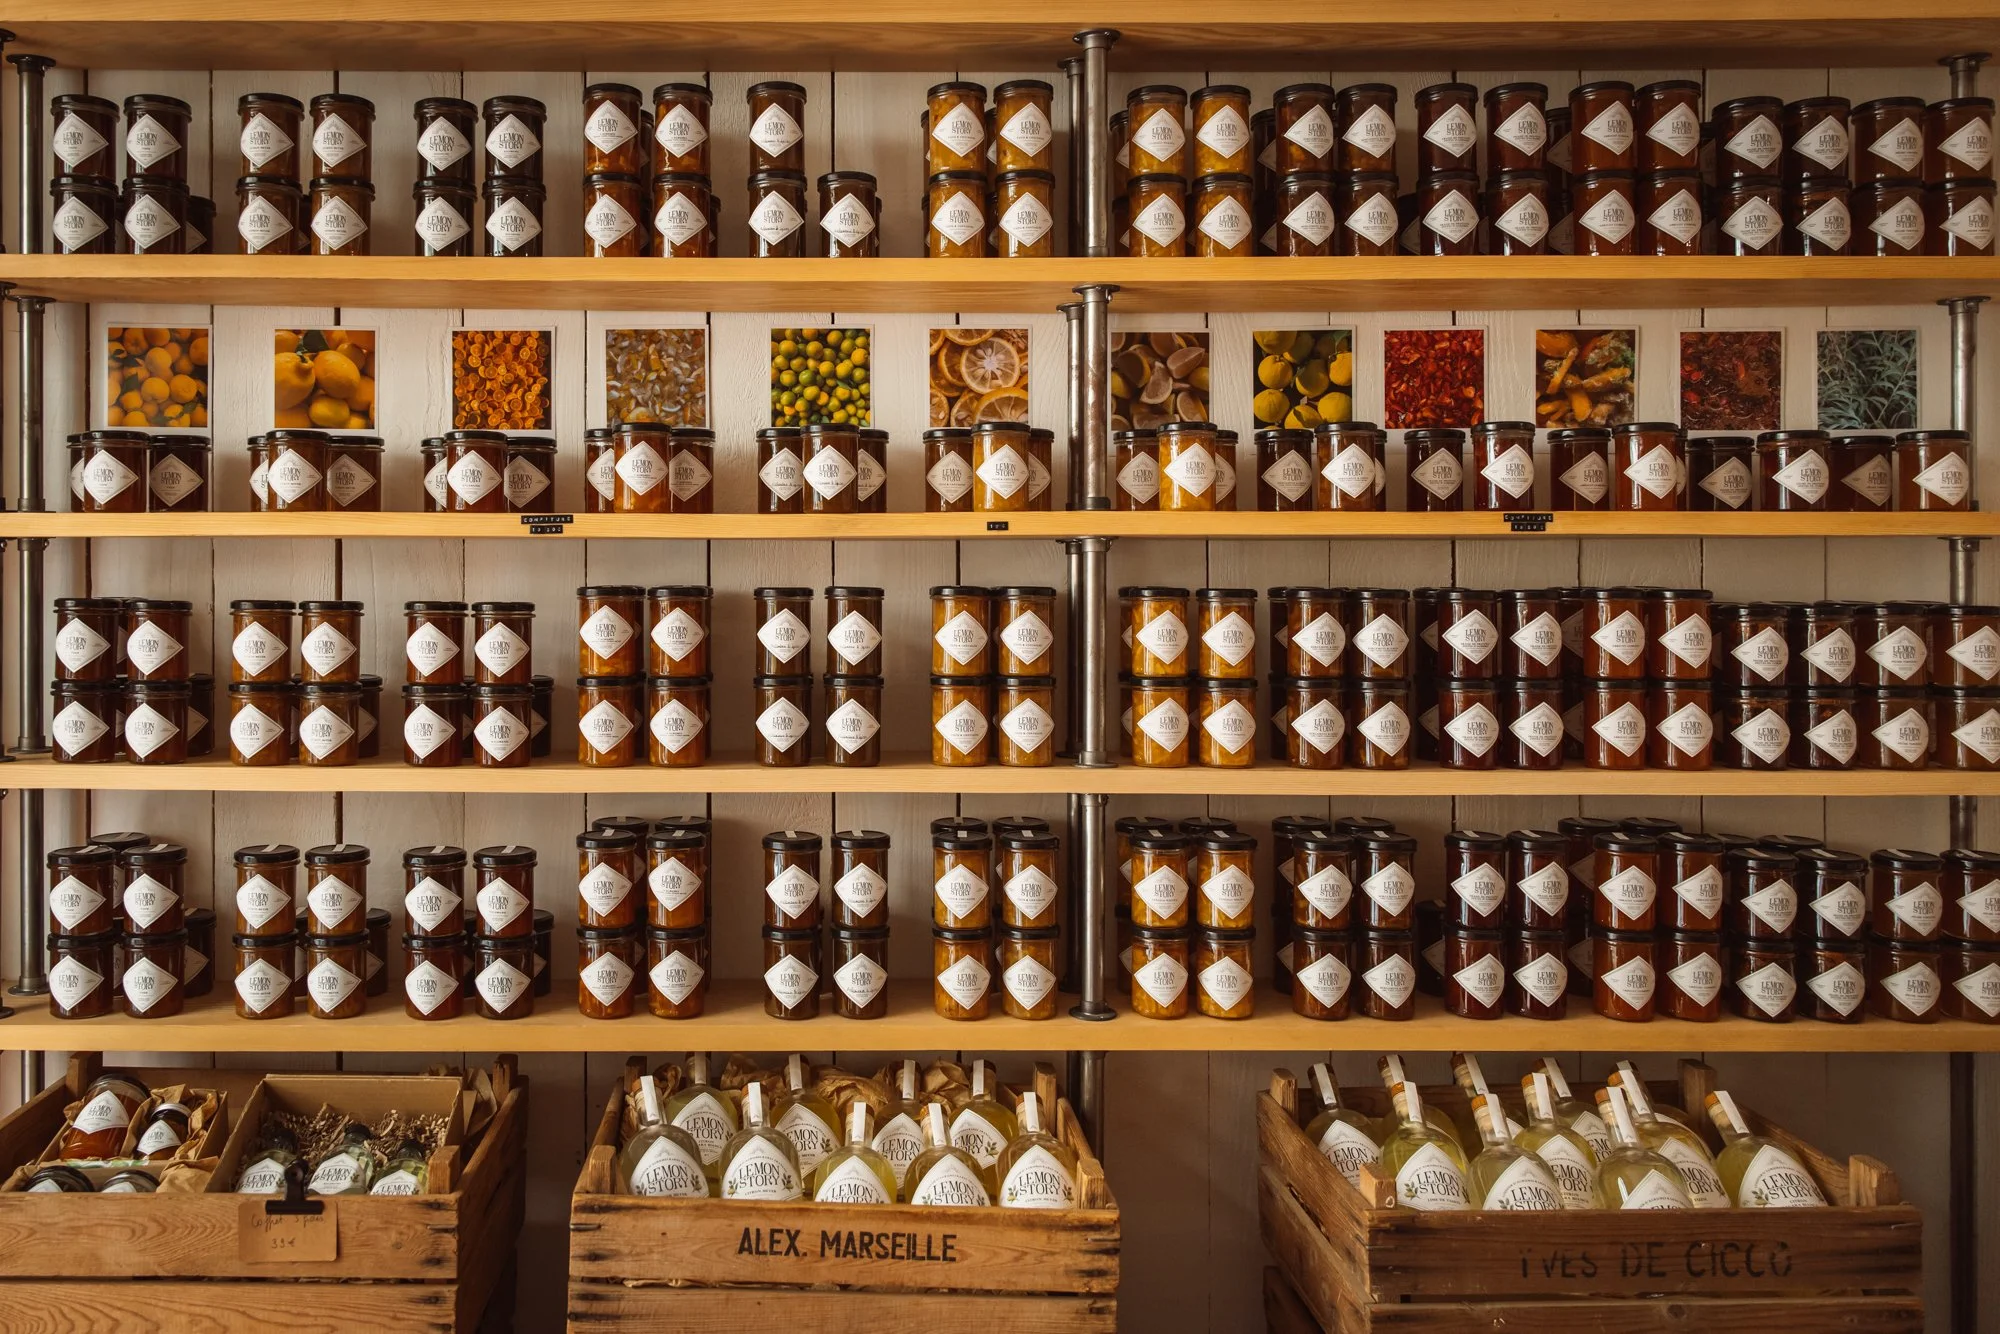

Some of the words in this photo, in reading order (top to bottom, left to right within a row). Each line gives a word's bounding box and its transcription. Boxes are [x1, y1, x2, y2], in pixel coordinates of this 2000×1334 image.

[669, 122, 690, 130] LEMON
[1020, 121, 1041, 129] LEMON
[1366, 123, 1386, 131] LEMON
[1446, 128, 1467, 136] STORY
[136, 138, 158, 146] STORY
[429, 135, 454, 145] LEMON
[498, 133, 523, 142] LEMON
[1819, 134, 1841, 142] LEMON
[429, 142, 453, 152] STORY
[498, 140, 523, 149] STORY
[1819, 140, 1841, 148] STORY
[1444, 208, 1465, 216] LEMON
[249, 214, 271, 222] LEMON
[427, 216, 453, 225] LEMON
[500, 216, 526, 225] LEMON
[1444, 214, 1465, 222] STORY
[1603, 214, 1624, 222] STORY
[427, 223, 453, 232] STORY
[500, 223, 526, 232] STORY
[819, 464, 840, 472] LEMON
[942, 468, 962, 476] LEMON
[508, 474, 533, 483] LEMON
[819, 470, 840, 478] STORY
[1432, 471, 1453, 479] STORY
[508, 481, 533, 490] STORY
[667, 626, 688, 634] LEMON
[776, 633, 796, 641] STORY
[490, 641, 510, 649] LEMON
[490, 647, 510, 655] STORY
[842, 718, 863, 726] LEMON
[1018, 717, 1039, 725] LEMON
[1680, 721, 1702, 729] LEMON
[490, 725, 511, 733] LEMON
[842, 724, 863, 732] STORY
[1533, 727, 1554, 735] STORY
[1680, 727, 1702, 735] STORY
[490, 731, 511, 739] STORY
[661, 881, 683, 889] STORY
[784, 889, 805, 897] STORY
[417, 896, 442, 905] LEMON
[489, 896, 509, 904] LEMON
[417, 903, 442, 912] STORY
[489, 902, 509, 910] STORY
[666, 969, 686, 977] LEMON
[852, 972, 871, 980] LEMON
[250, 977, 271, 985] LEMON
[488, 977, 511, 987] LEMON
[852, 978, 871, 986] STORY
[250, 983, 271, 991] STORY
[488, 984, 511, 994] STORY
[686, 1116, 724, 1131] LEMON
[882, 1138, 921, 1152] LEMON
[321, 1167, 352, 1177] LEMON
[646, 1164, 688, 1184] LEMON
[739, 1162, 780, 1179] LEMON
[246, 1173, 278, 1184] LEMON
[320, 1173, 350, 1182] STORY
[740, 1173, 780, 1189] STORY
[1018, 1171, 1061, 1186] LEMON
[1416, 1172, 1460, 1189] LEMON
[1762, 1173, 1808, 1190] LEMON
[246, 1180, 274, 1189] STORY
[381, 1183, 411, 1192] LEMON
[648, 1176, 689, 1194] STORY
[933, 1180, 975, 1196] LEMON
[1020, 1181, 1061, 1196] STORY
[1558, 1177, 1588, 1193] TORY
[832, 1183, 874, 1199] LEMON
[1419, 1183, 1460, 1198] STORY
[1511, 1186, 1554, 1203] LEMON
[1768, 1184, 1811, 1200] STORY
[934, 1192, 976, 1205] STORY
[738, 1227, 808, 1257] ALEX.
[820, 1230, 957, 1262] MARSEILLE
[1620, 1242, 1667, 1278] DE
